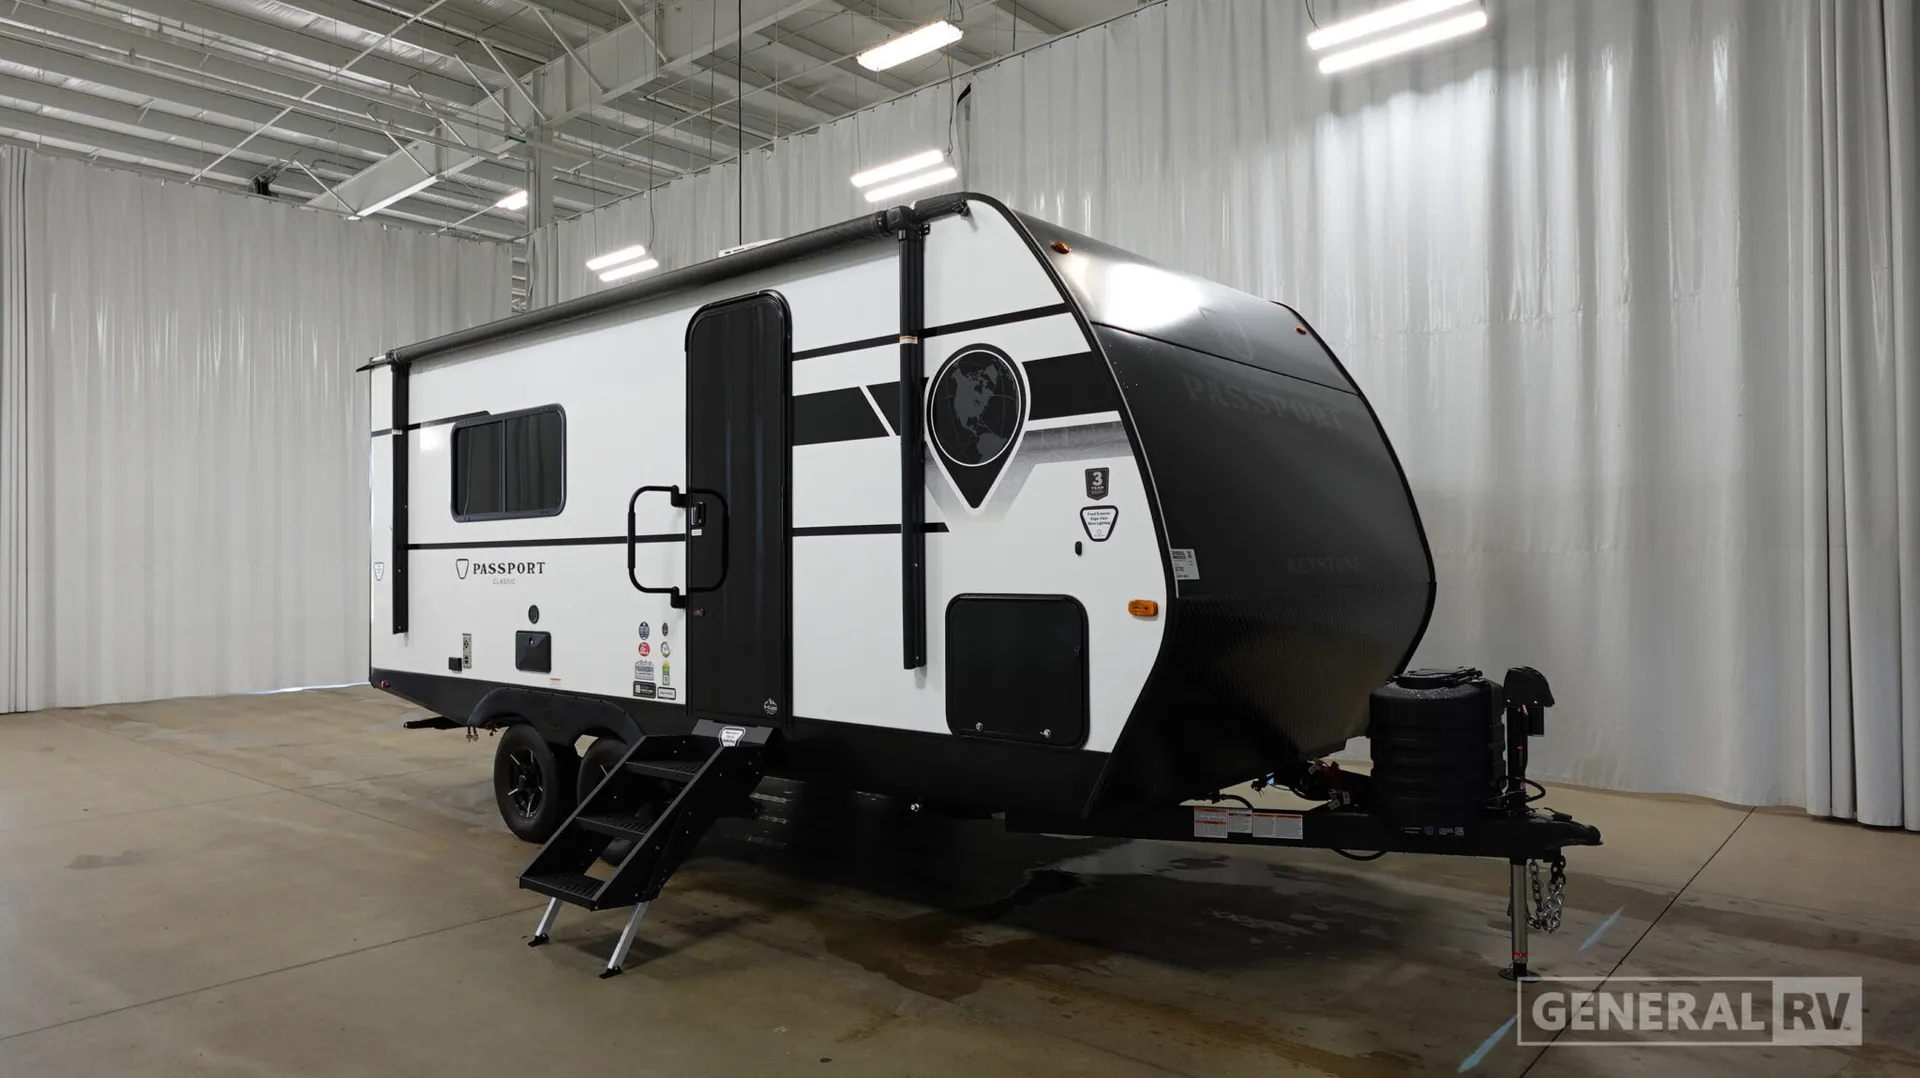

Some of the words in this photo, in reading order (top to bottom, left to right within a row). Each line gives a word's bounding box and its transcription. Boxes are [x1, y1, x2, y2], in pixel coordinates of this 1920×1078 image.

[1178, 372, 1344, 431] PASSPORT
[1092, 471, 1103, 486] 3
[473, 561, 546, 575] PASSPORT
[1286, 555, 1363, 574] KEYSTONE
